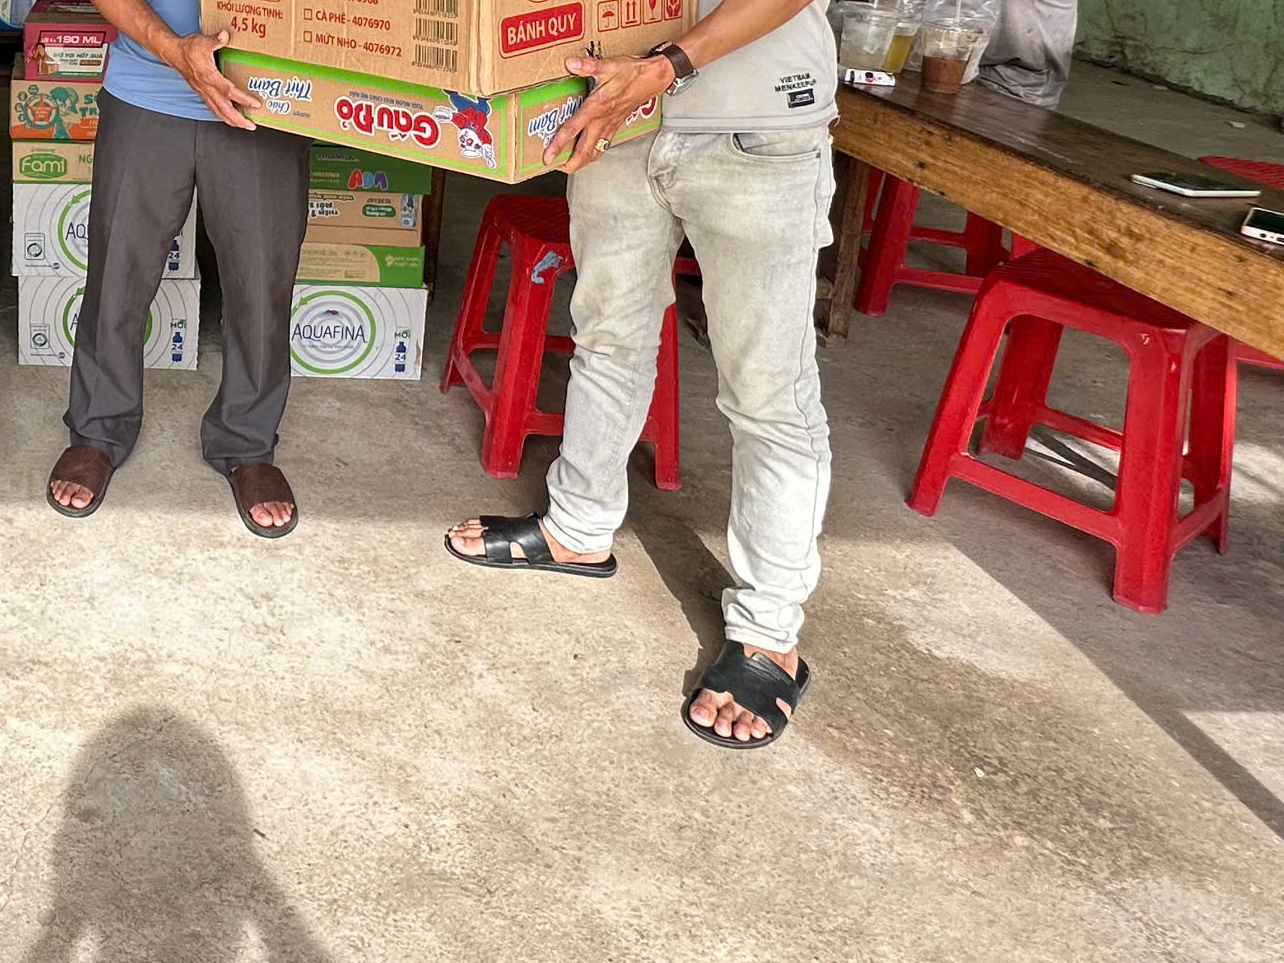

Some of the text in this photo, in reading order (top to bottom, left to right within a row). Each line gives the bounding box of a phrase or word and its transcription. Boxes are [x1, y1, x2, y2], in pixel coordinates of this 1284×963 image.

[231, 16, 266, 38] 4,5 kg
[316, 9, 327, 21] CÀ
[352, 16, 390, 31] 4076970
[507, 12, 576, 45] BÁNH QUY
[337, 35, 356, 49] NHO
[363, 41, 402, 57] 4076972
[291, 323, 367, 343] AQUAFINA
[172, 343, 183, 351] 24
[395, 353, 406, 361] 24
